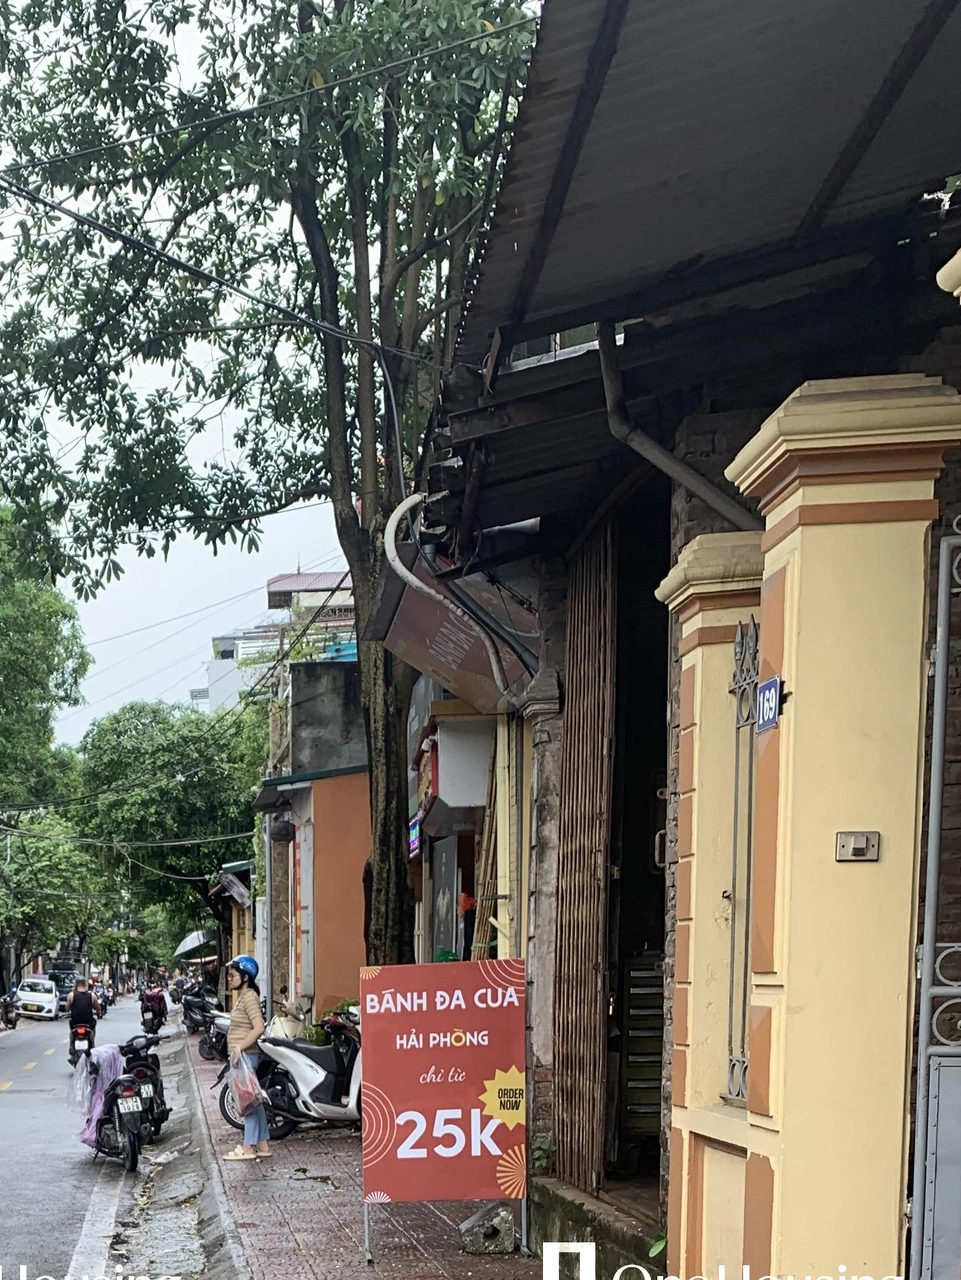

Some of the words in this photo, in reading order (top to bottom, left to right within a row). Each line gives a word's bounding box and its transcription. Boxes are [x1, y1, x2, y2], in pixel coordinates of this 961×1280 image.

[759, 687, 776, 725] 169
[366, 988, 427, 1013] BÁNH
[435, 988, 466, 1011] ĐA
[474, 986, 520, 1009] CUA
[396, 1028, 423, 1050] HẢI
[430, 1028, 489, 1047] PHÒNG
[419, 1064, 444, 1084] chỉ
[448, 1066, 467, 1084] từ
[497, 1088, 524, 1100] ORDER
[499, 1099, 521, 1111] NOW
